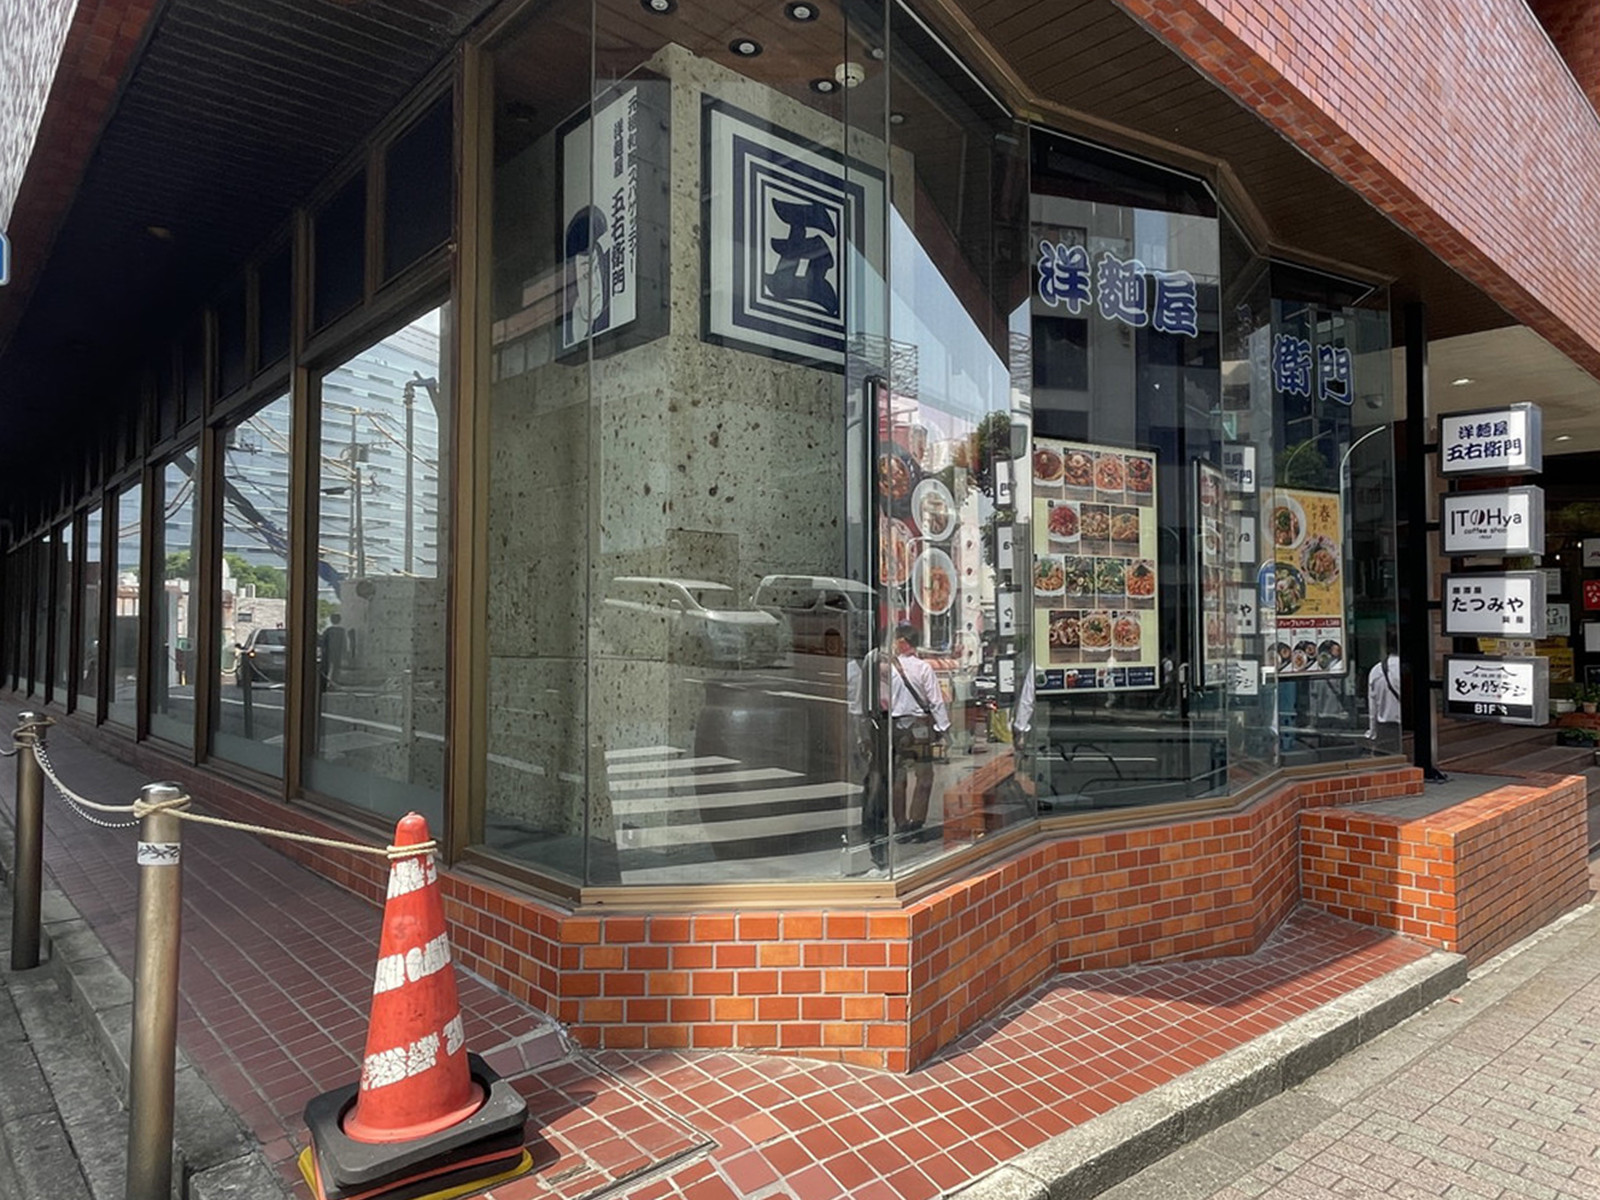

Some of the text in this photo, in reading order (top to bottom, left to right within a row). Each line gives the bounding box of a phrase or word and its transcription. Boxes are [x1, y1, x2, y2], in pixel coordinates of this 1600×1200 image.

[763, 197, 837, 316] 五
[1446, 438, 1522, 463] 五右衛門
[1464, 527, 1488, 535] coffee
[1451, 597, 1524, 612] たつみや
[1474, 703, 1496, 715] B1F
